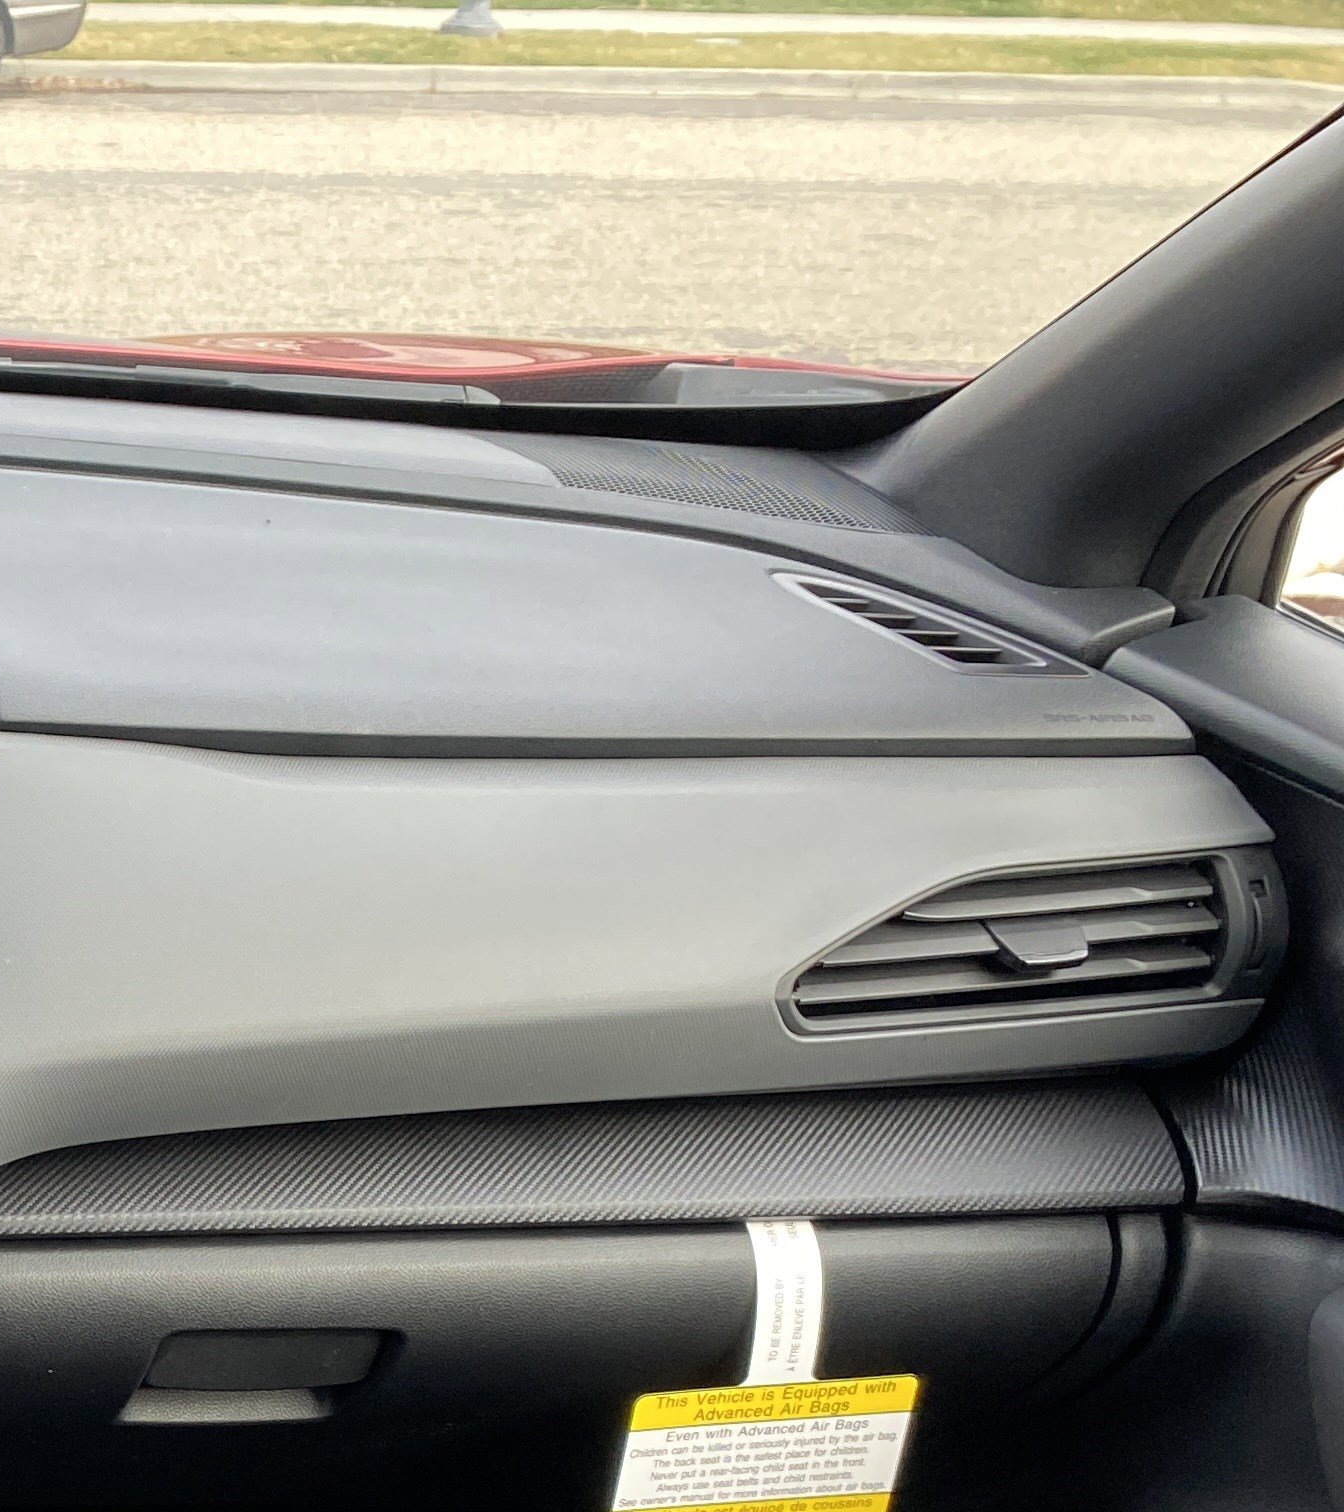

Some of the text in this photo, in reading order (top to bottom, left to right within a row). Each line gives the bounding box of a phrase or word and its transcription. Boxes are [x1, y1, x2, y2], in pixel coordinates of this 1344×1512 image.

[656, 1381, 896, 1409] This Vehicle is Equipped with
[694, 1399, 849, 1420] Advanced Air Bags
[666, 1418, 869, 1442] Even with Advanced Air Bags
[790, 1502, 807, 1512] de
[813, 1498, 872, 1510] coussins
